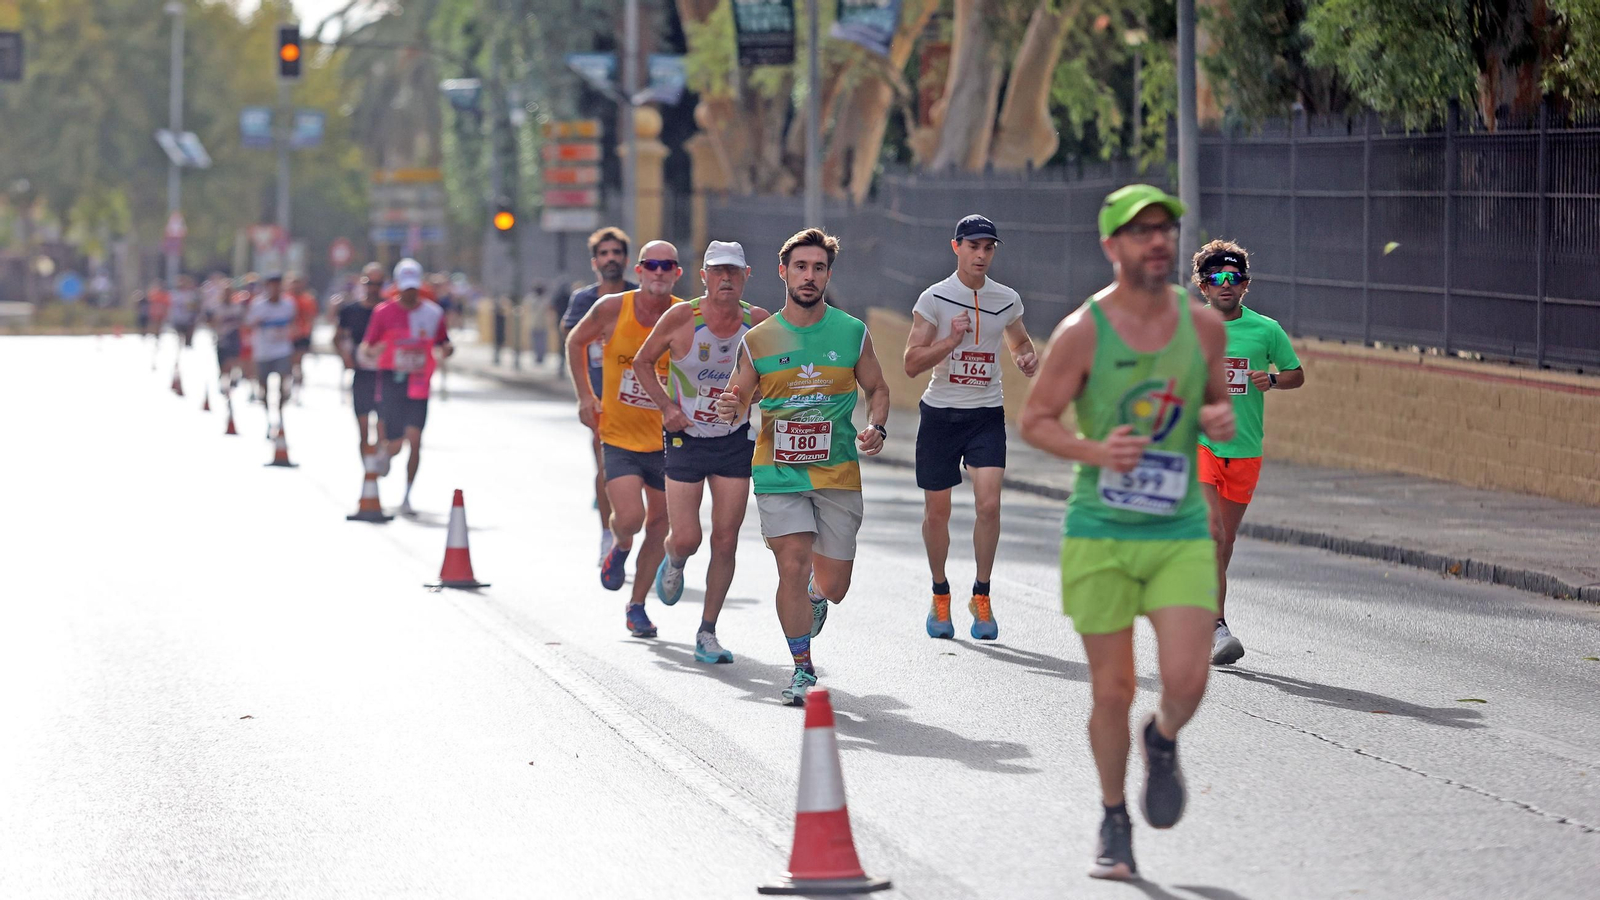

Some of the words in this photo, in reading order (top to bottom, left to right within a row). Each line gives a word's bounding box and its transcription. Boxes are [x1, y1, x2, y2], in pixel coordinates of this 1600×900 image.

[962, 362, 987, 376] 164
[788, 435, 817, 450] 180
[1121, 471, 1164, 492] 599
